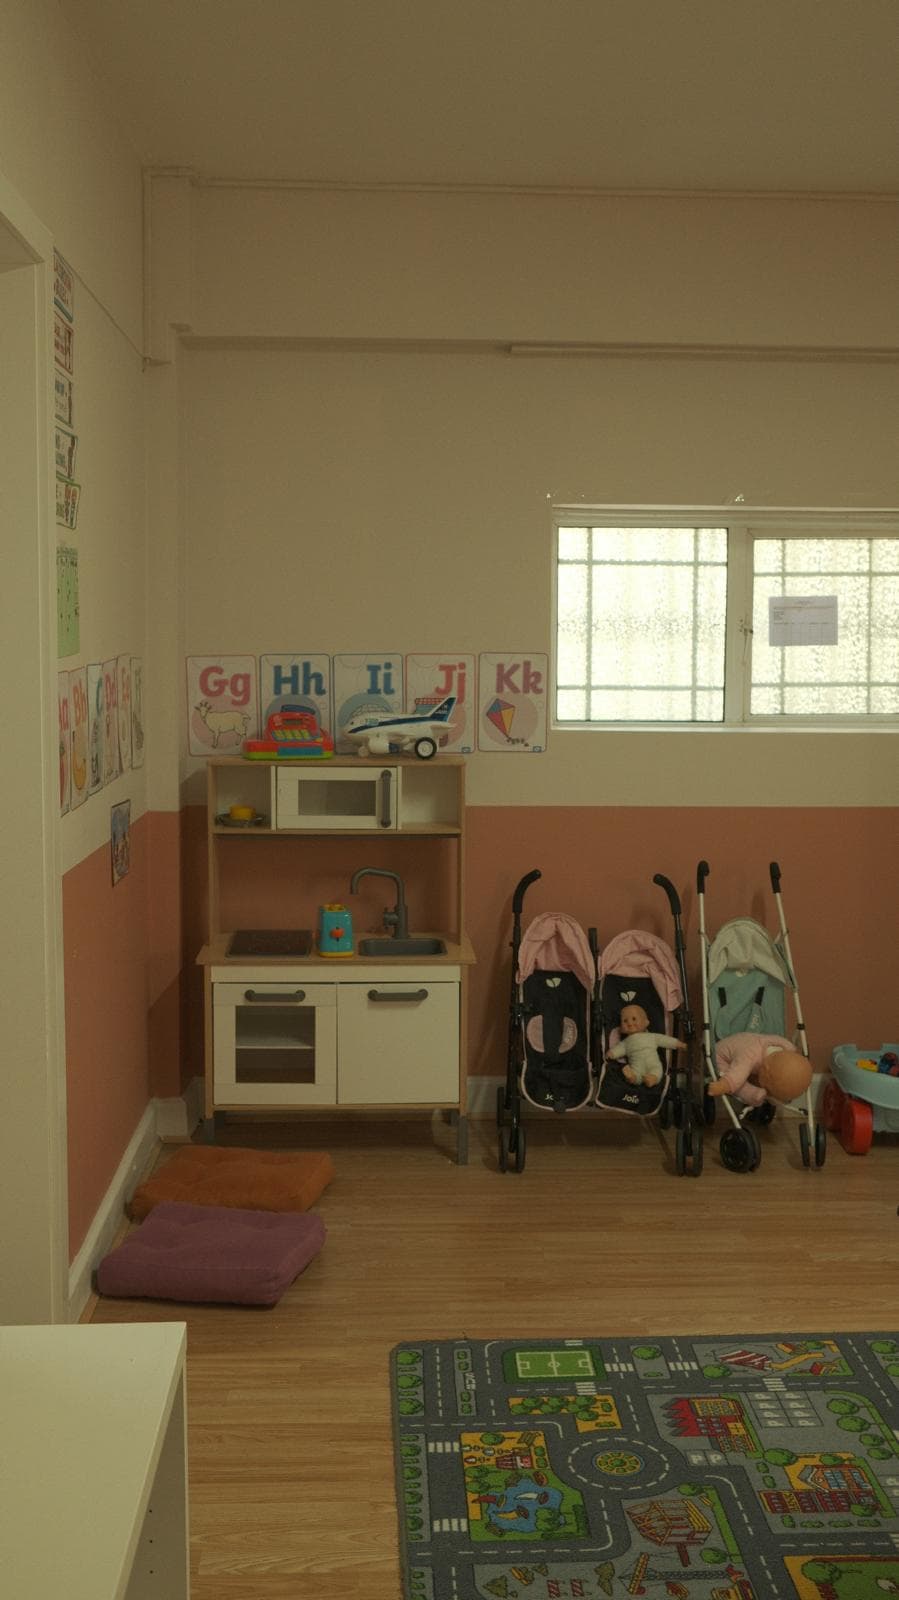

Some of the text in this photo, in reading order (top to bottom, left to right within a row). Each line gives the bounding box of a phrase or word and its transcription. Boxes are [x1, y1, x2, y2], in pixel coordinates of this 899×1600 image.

[200, 665, 252, 706] Gg
[273, 661, 327, 697] Hh
[366, 663, 395, 696] Ii
[434, 661, 467, 706] Jj
[495, 661, 544, 695] Kk
[622, 1093, 640, 1105] Joie
